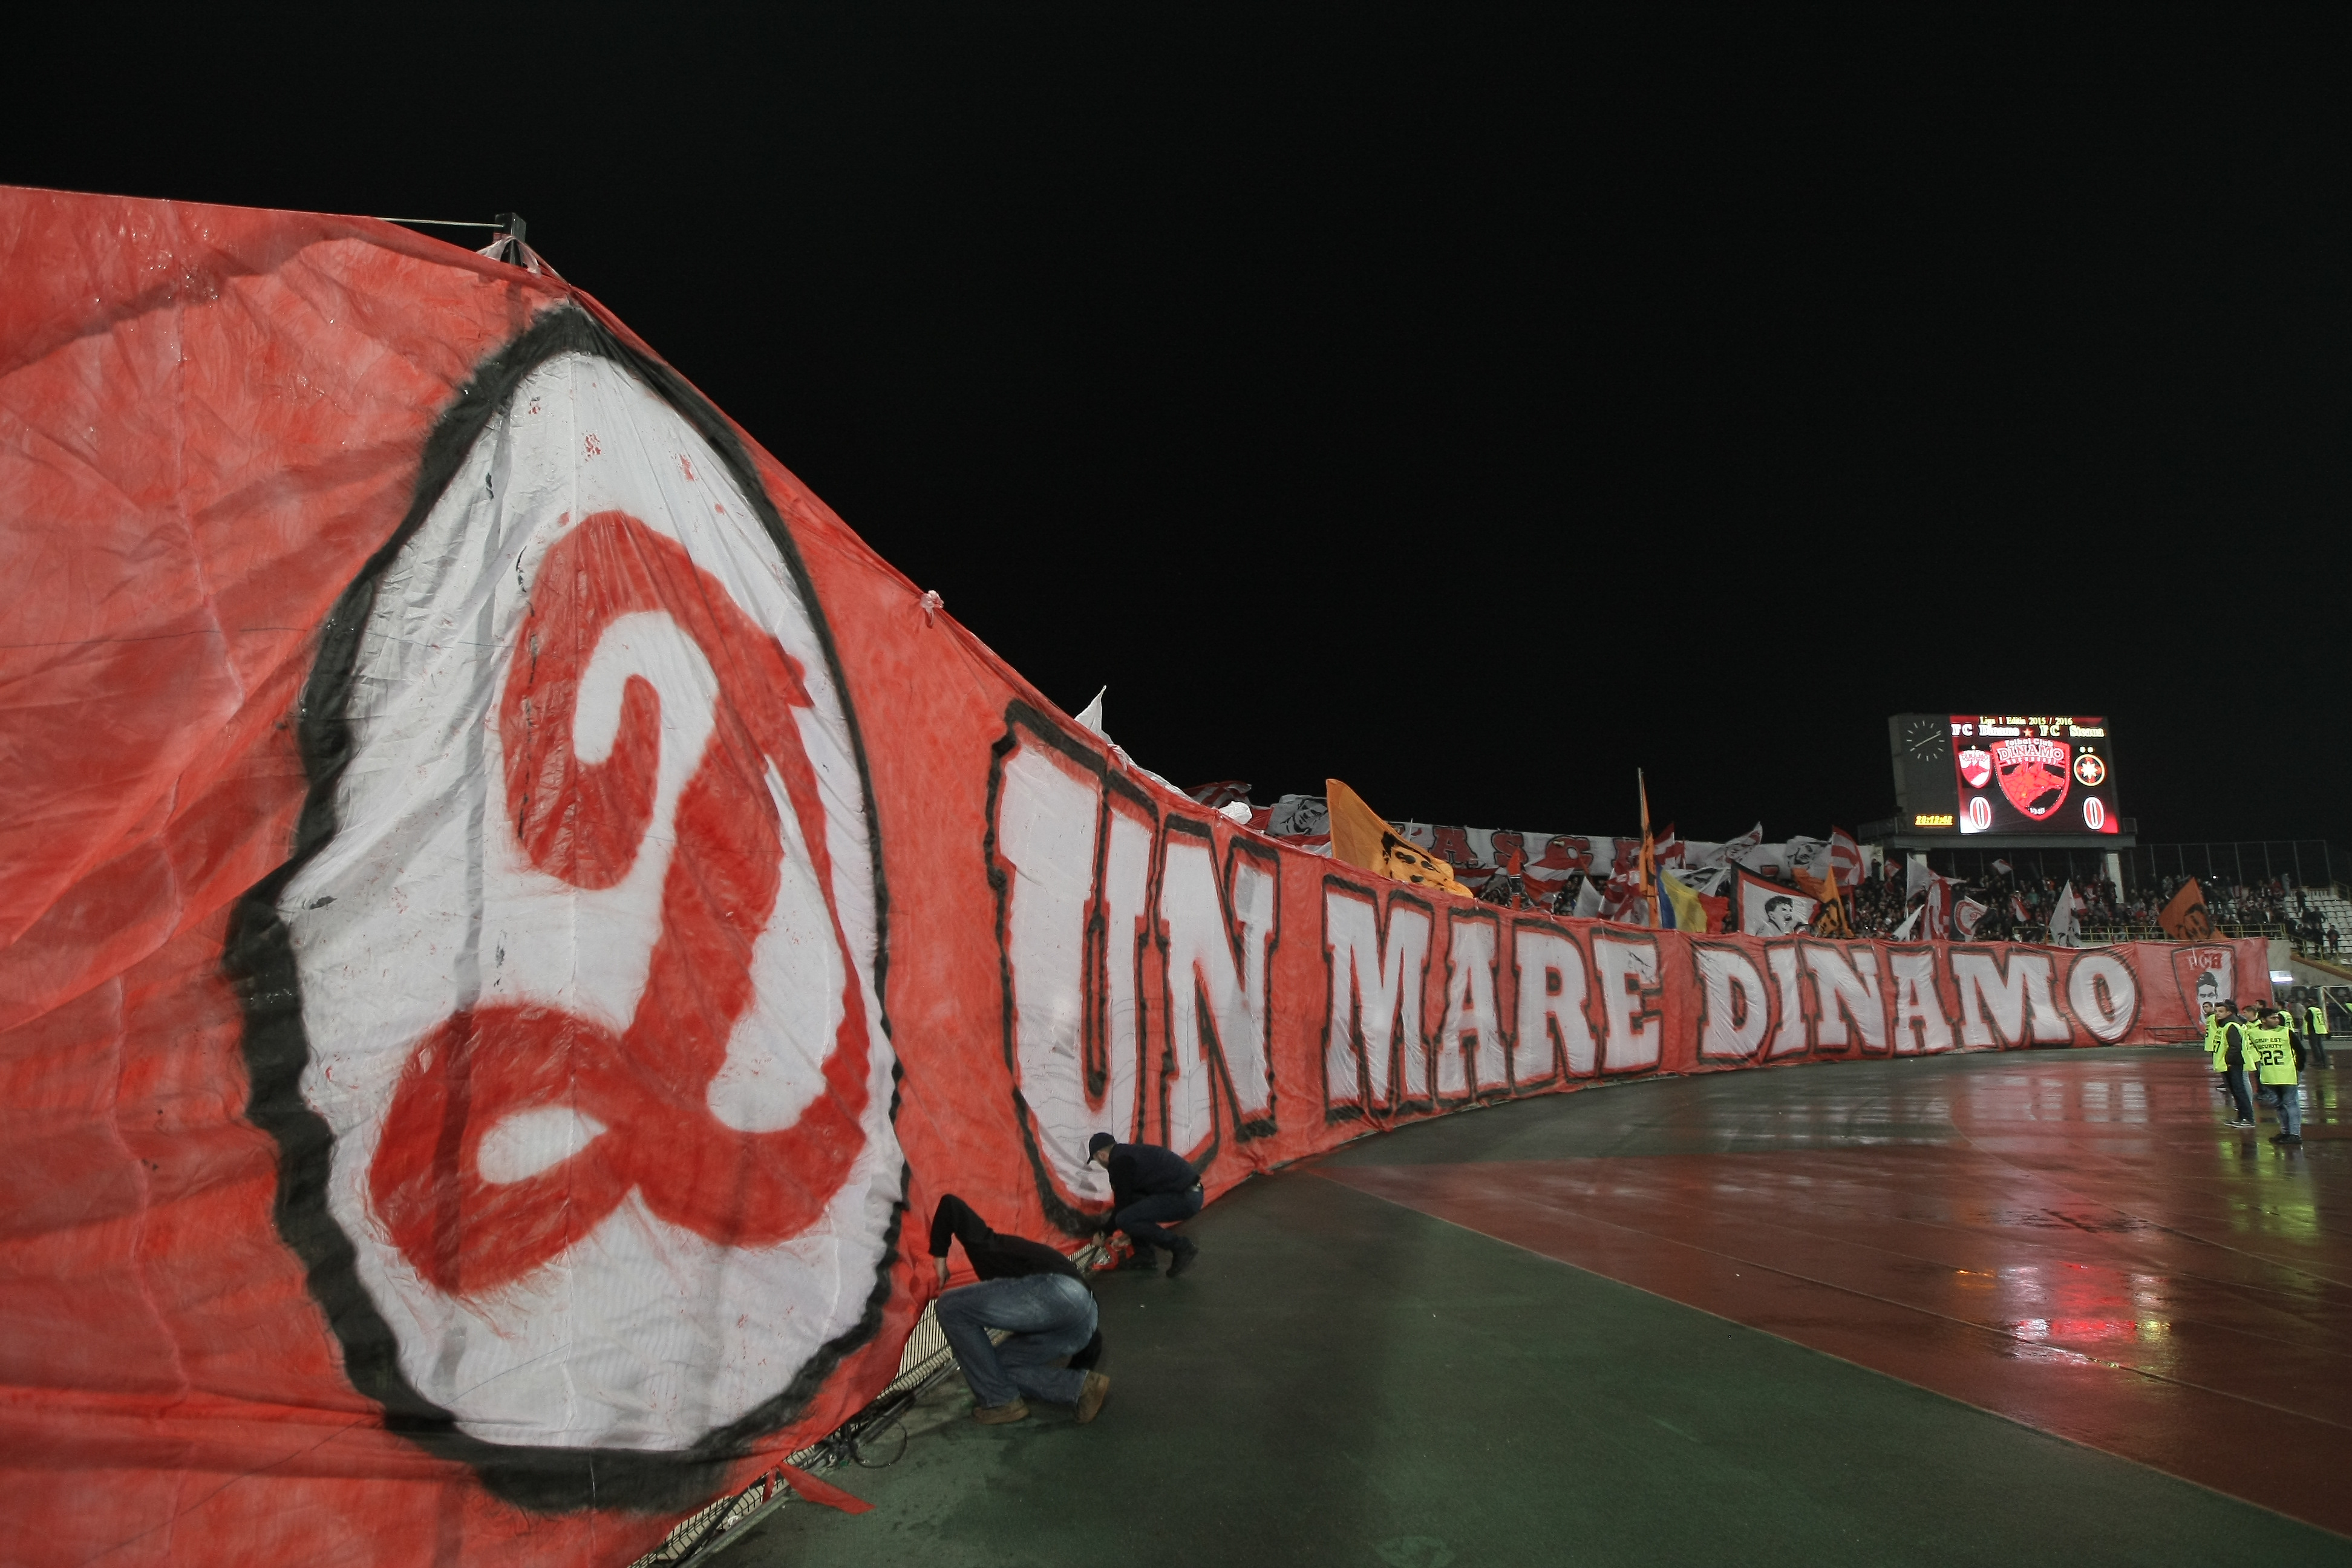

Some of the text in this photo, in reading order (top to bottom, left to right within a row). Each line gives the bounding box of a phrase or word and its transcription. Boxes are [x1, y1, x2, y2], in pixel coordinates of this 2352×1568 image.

[2028, 717, 2047, 725] 2015
[2054, 717, 2074, 725] 2016
[1951, 724, 1973, 736] FC
[2039, 725, 2060, 737] FC
[2033, 738, 2054, 747] Club
[1996, 744, 2064, 761] DINAMO
[1969, 795, 1991, 831] 0
[2082, 795, 2105, 831] 0
[986, 699, 1280, 1239] UN
[1323, 873, 1665, 1123] MARE
[1692, 939, 2143, 1064] DINAMO
